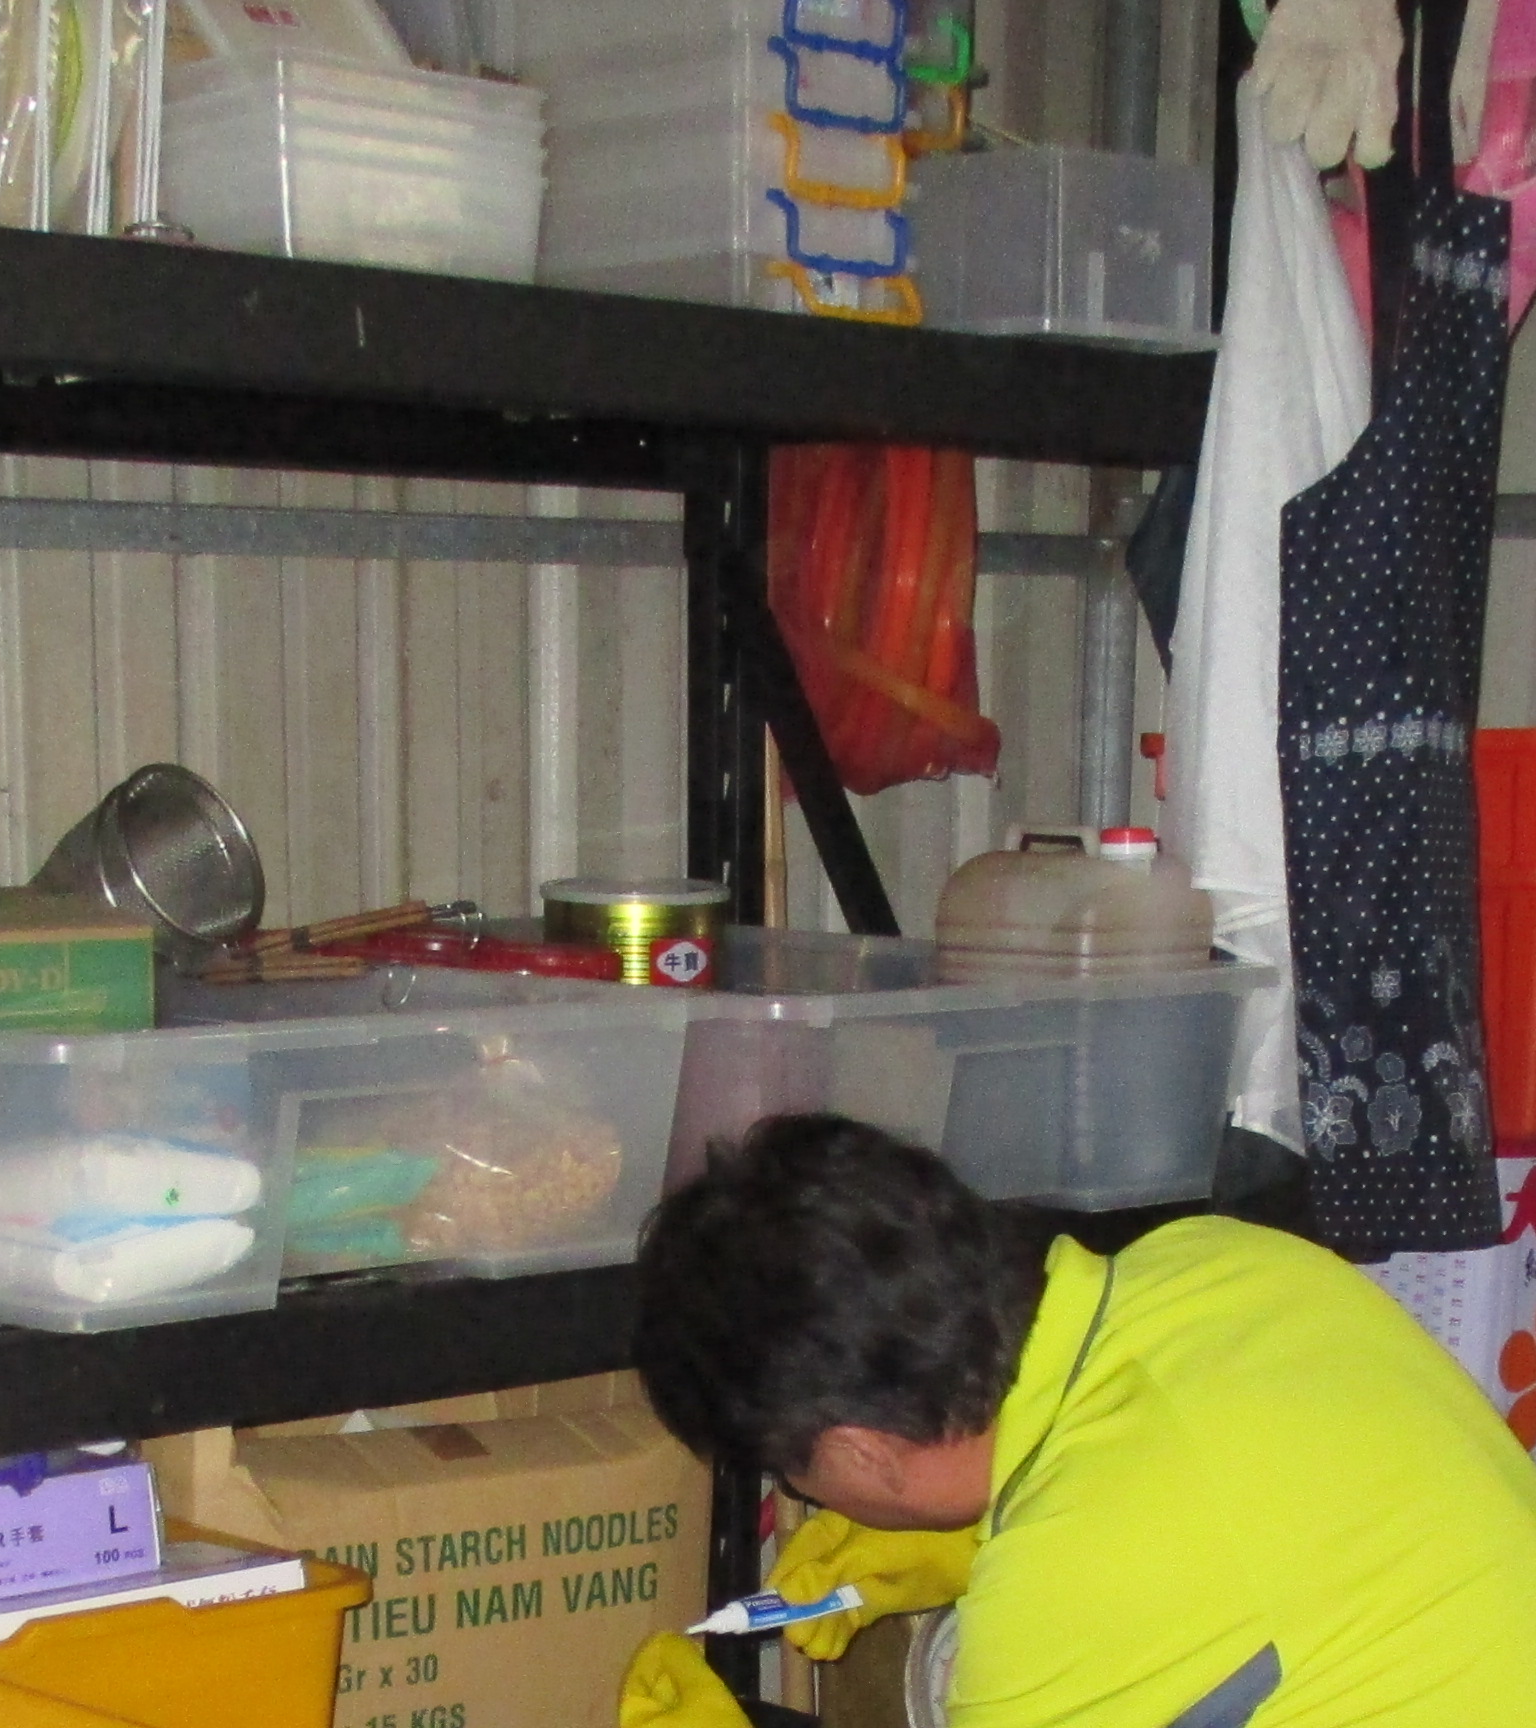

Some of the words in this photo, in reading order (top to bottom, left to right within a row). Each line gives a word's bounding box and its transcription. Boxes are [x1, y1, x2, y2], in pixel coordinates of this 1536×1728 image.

[109, 1504, 129, 1535] L
[95, 1548, 121, 1565] 100
[397, 1524, 527, 1577] STARCH
[542, 1503, 678, 1557] NOODLES
[456, 1580, 543, 1629] NAM
[562, 1562, 658, 1613] VANG
[406, 1652, 439, 1686] 30
